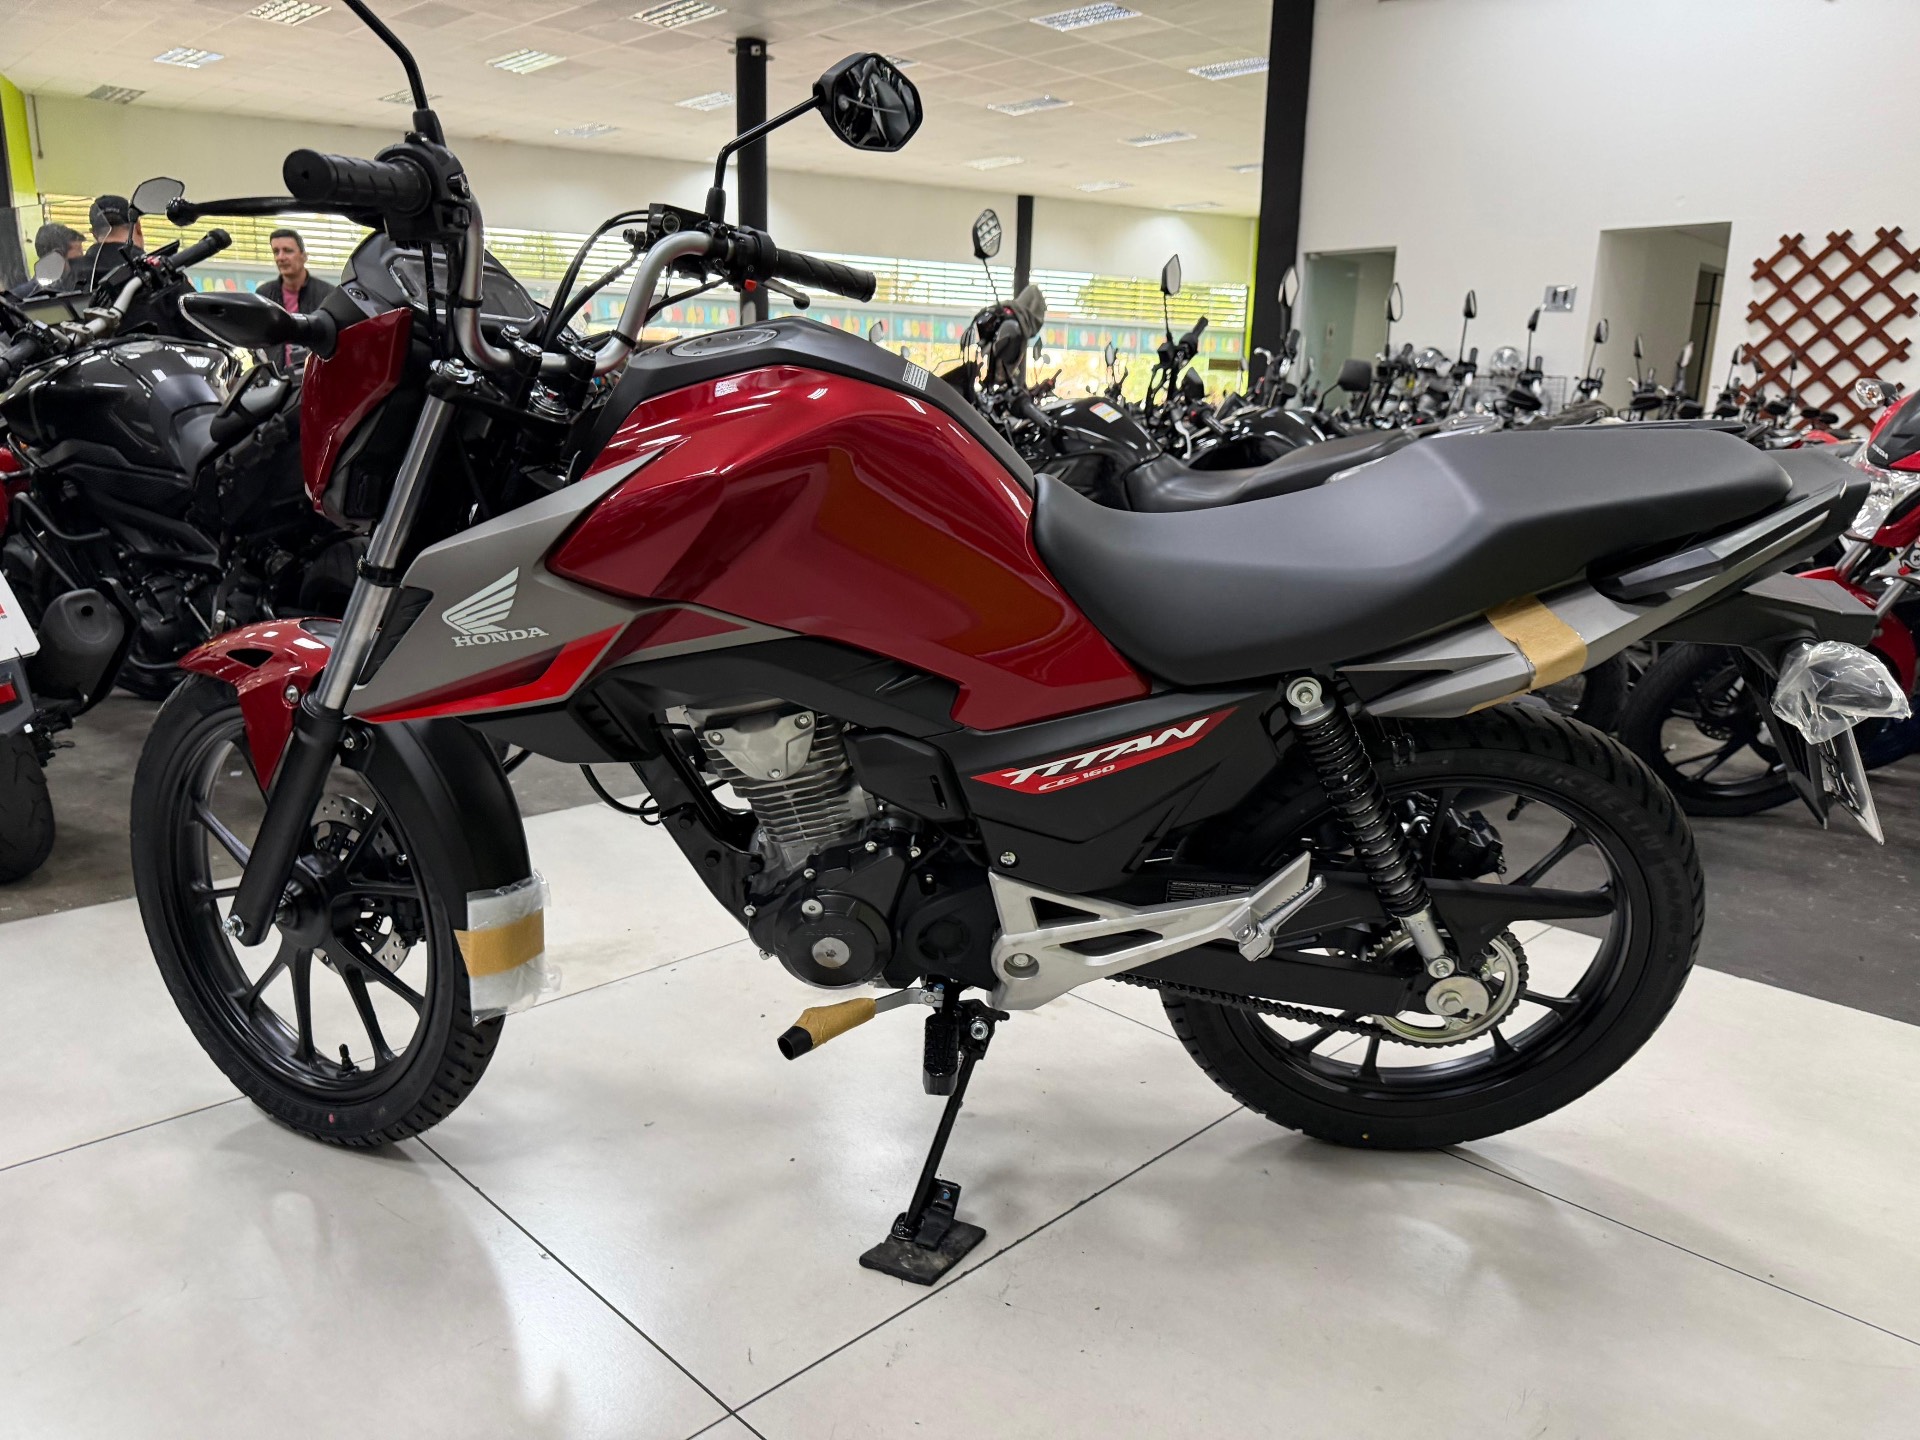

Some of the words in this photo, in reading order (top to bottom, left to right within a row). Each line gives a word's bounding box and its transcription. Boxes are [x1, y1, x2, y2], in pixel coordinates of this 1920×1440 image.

[451, 626, 549, 647] HONDA
[1001, 717, 1209, 785] TITAN
[1038, 775, 1079, 791] CG
[1083, 764, 1115, 779] 160
